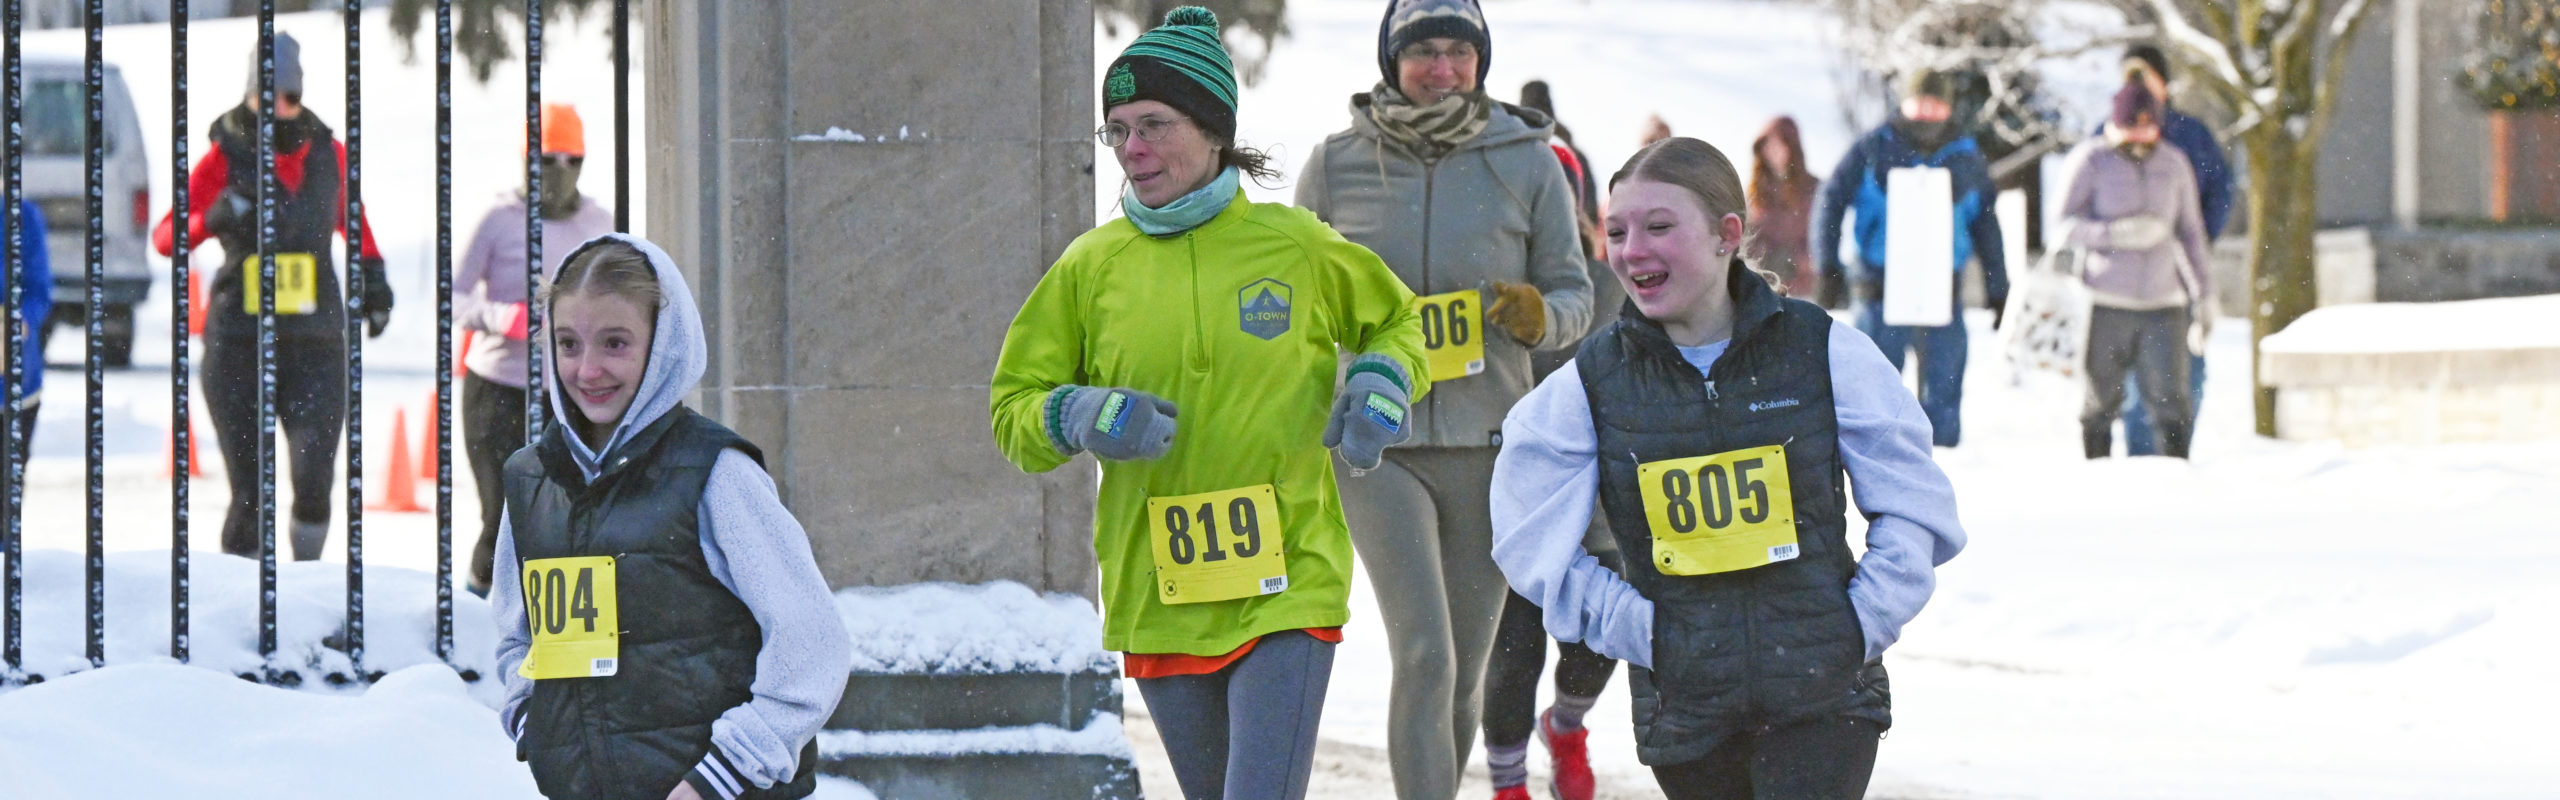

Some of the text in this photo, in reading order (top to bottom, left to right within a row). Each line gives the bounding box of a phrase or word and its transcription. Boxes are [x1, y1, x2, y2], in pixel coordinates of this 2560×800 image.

[275, 262, 303, 291] 18
[1245, 311, 1287, 322] O-TOWN
[1421, 299, 1468, 350] 06
[1758, 398, 1800, 410] Columbia
[1661, 457, 1769, 533] 805
[1165, 497, 1261, 565] 819
[528, 567, 598, 636] 804
